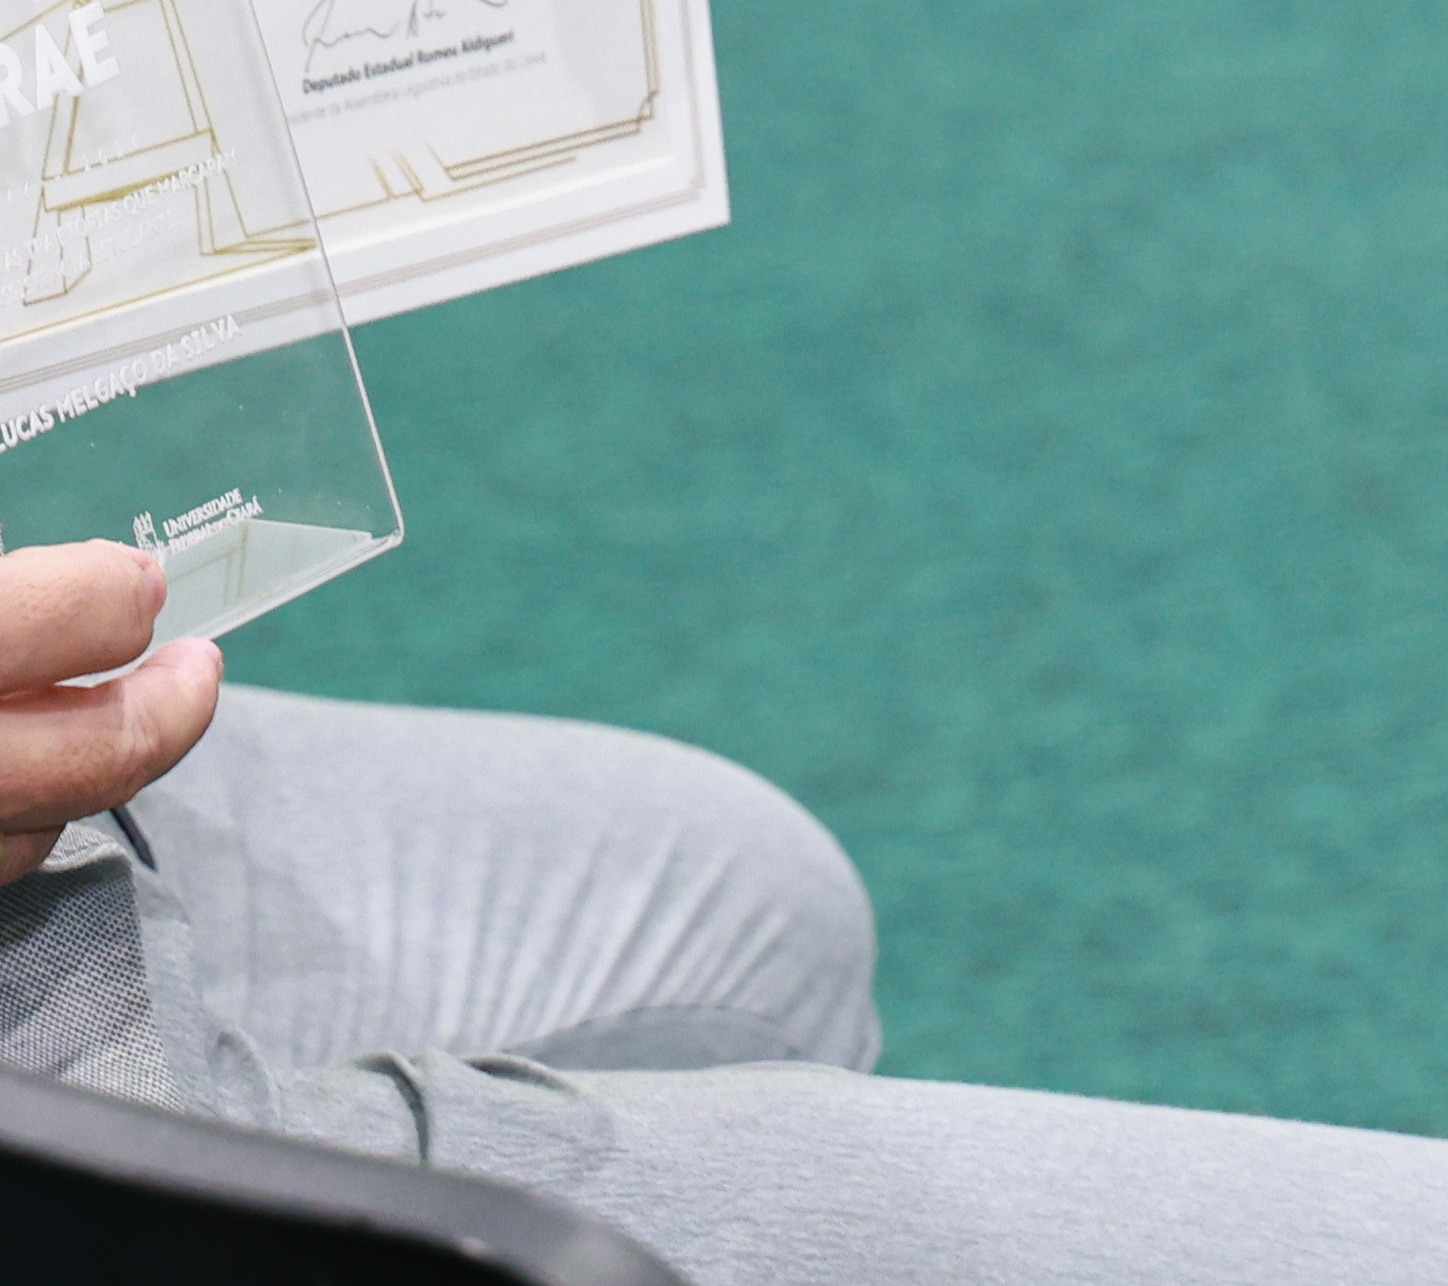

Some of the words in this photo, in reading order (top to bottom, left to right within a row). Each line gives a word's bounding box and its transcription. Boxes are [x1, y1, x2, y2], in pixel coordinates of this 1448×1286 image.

[56, 358, 148, 424] MELGAÇO
[150, 343, 181, 375] DA
[180, 313, 242, 361] SILVA
[162, 487, 243, 538] UNIVERSIDADE
